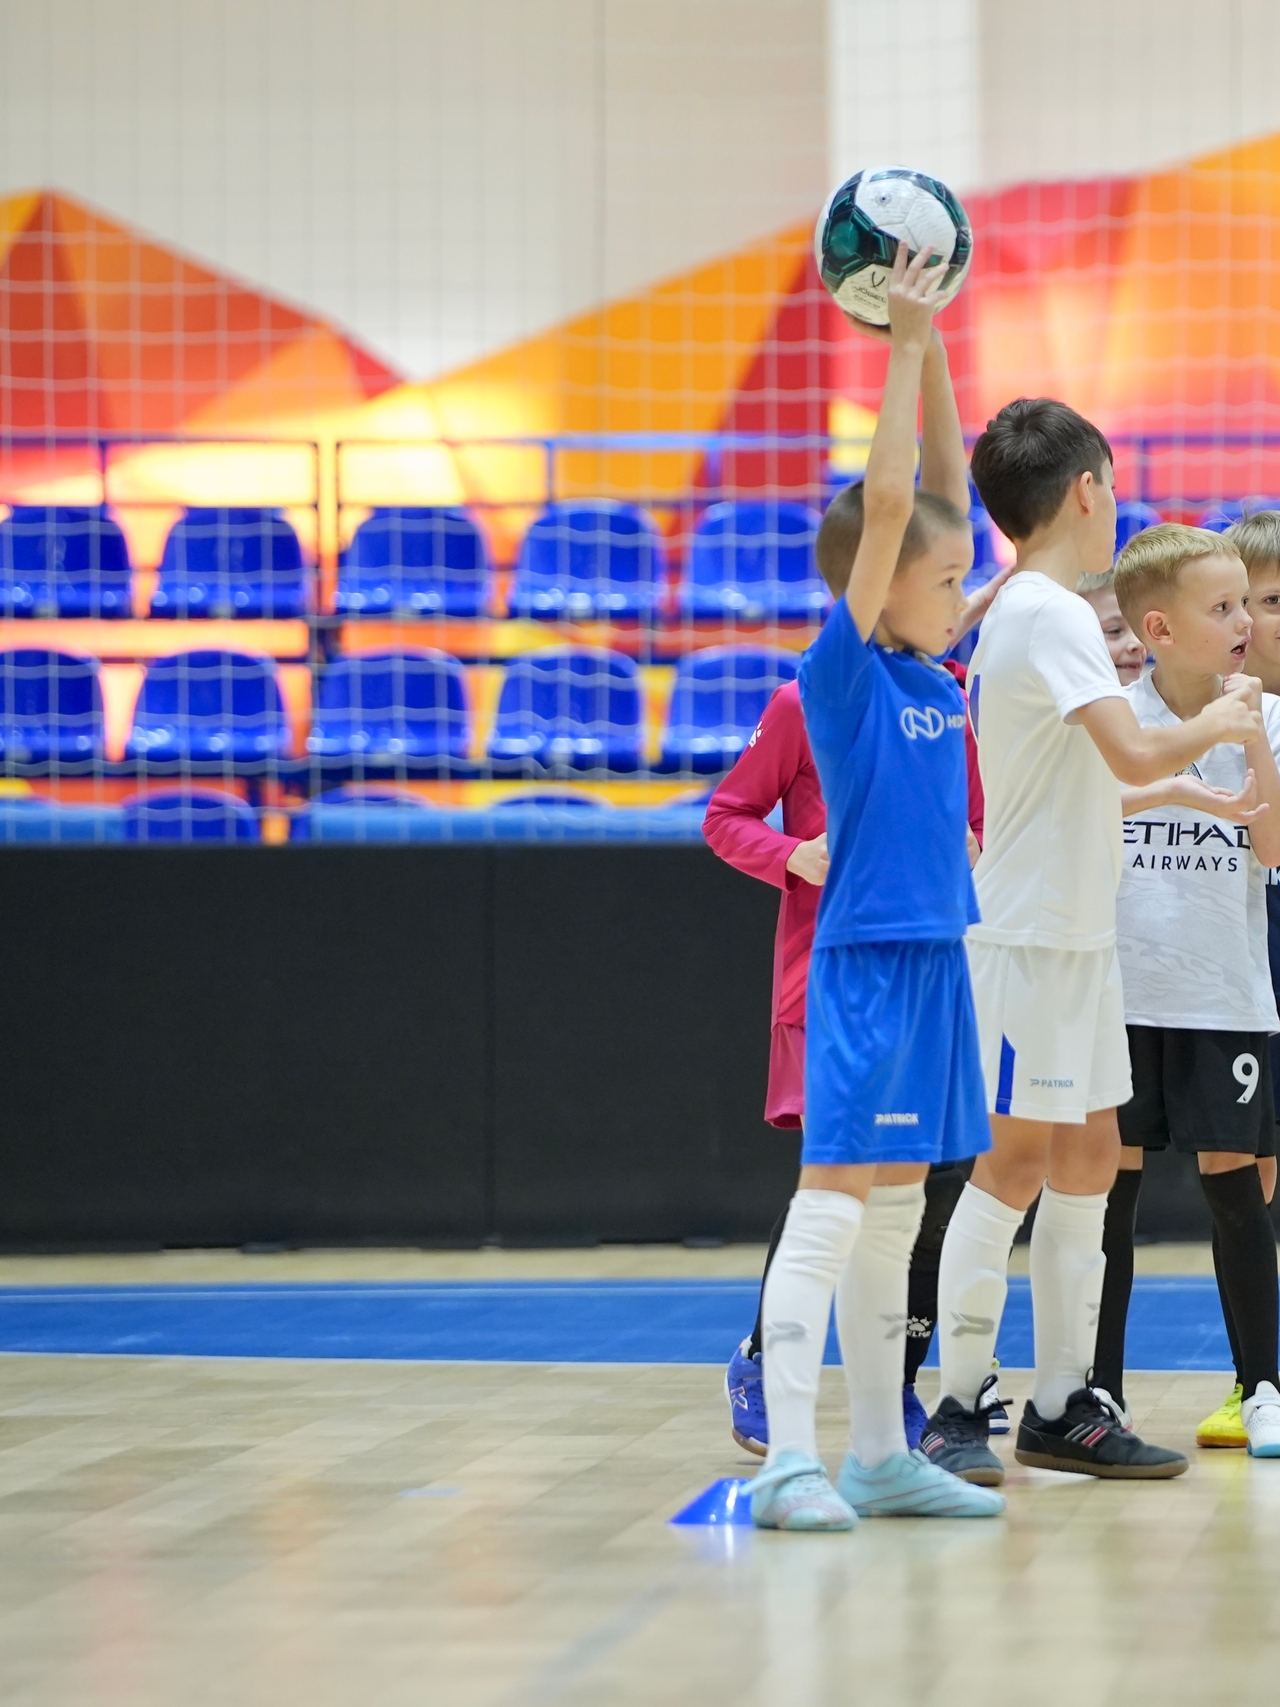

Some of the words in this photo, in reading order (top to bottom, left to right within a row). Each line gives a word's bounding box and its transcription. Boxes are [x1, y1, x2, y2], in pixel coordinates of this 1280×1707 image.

[1132, 853, 1238, 872] AIRWAYS
[1041, 1079, 1075, 1088] PATRICK
[1232, 1052, 1260, 1104] 9
